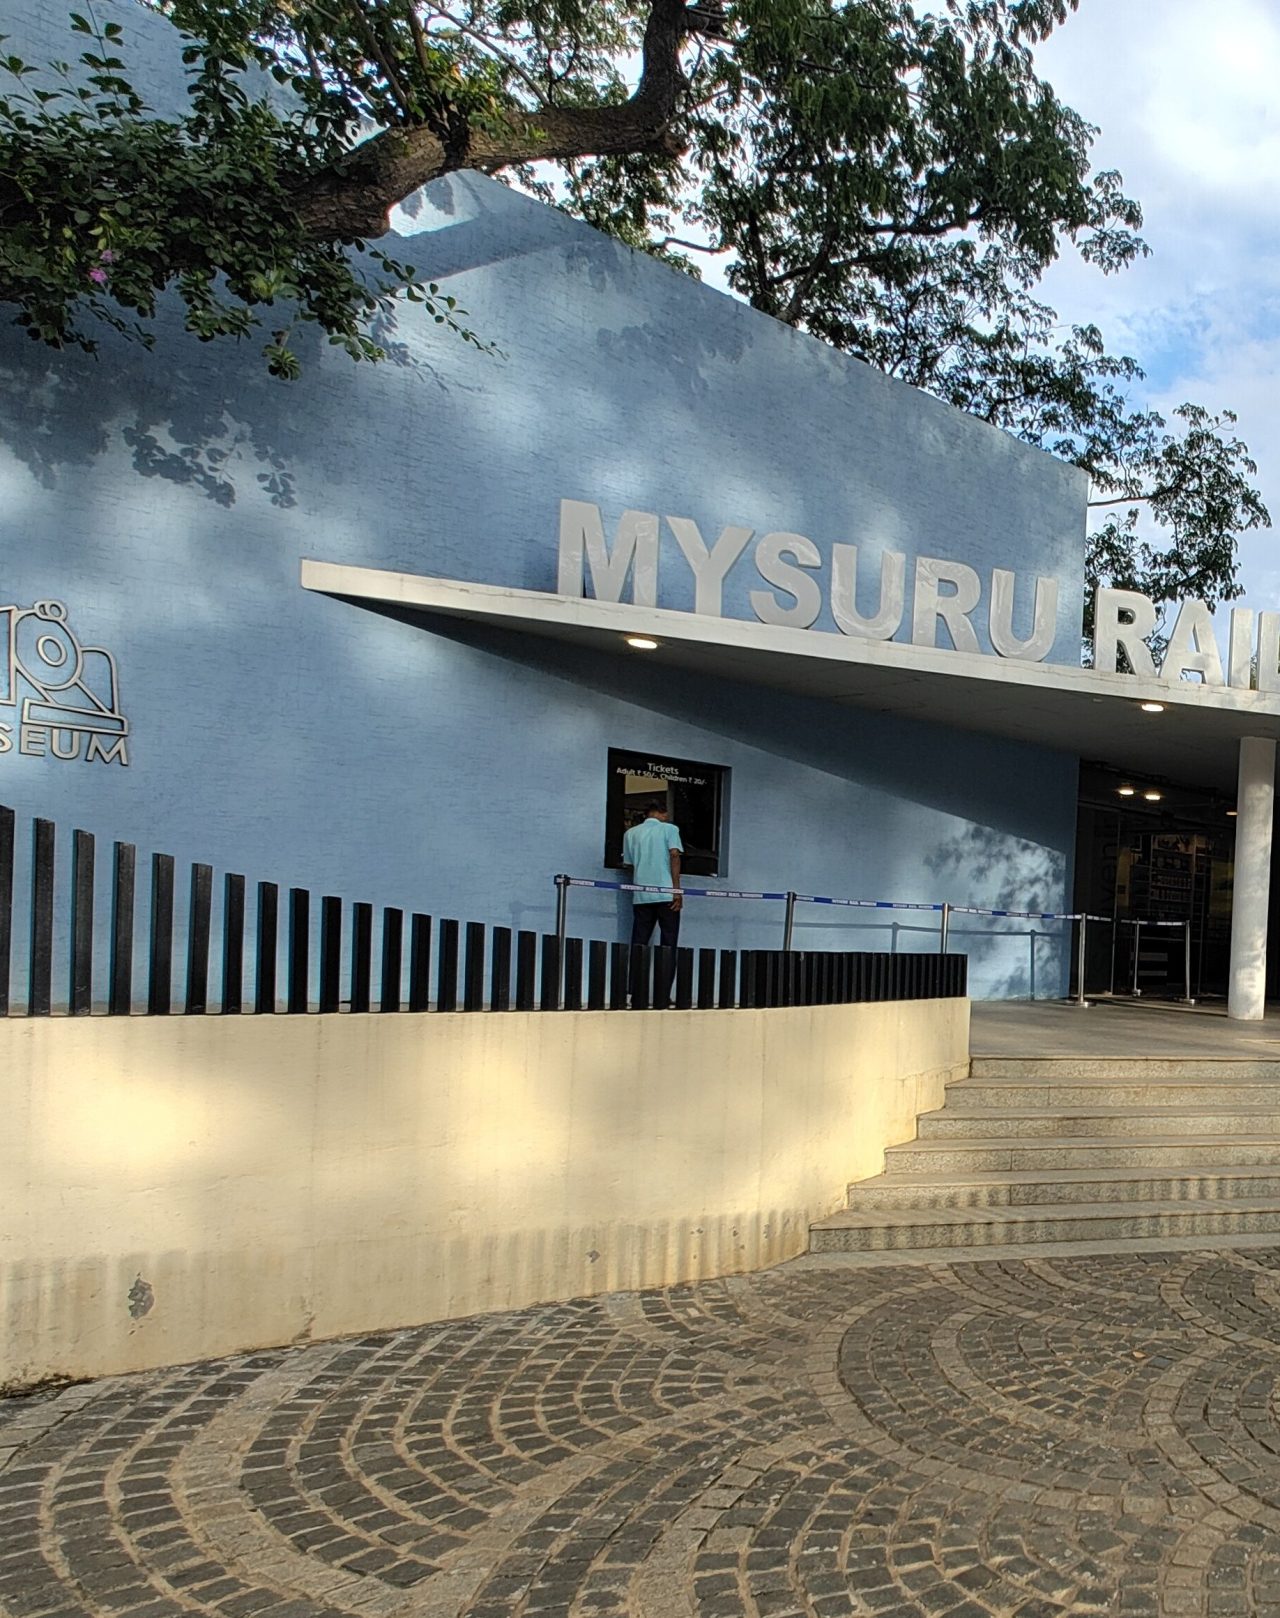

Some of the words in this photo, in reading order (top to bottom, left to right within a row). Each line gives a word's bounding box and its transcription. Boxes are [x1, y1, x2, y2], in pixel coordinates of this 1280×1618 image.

[557, 498, 1058, 663] MYSURU
[616, 767, 636, 776] Adult
[660, 773, 688, 783] Children
[647, 762, 679, 775] Tickets
